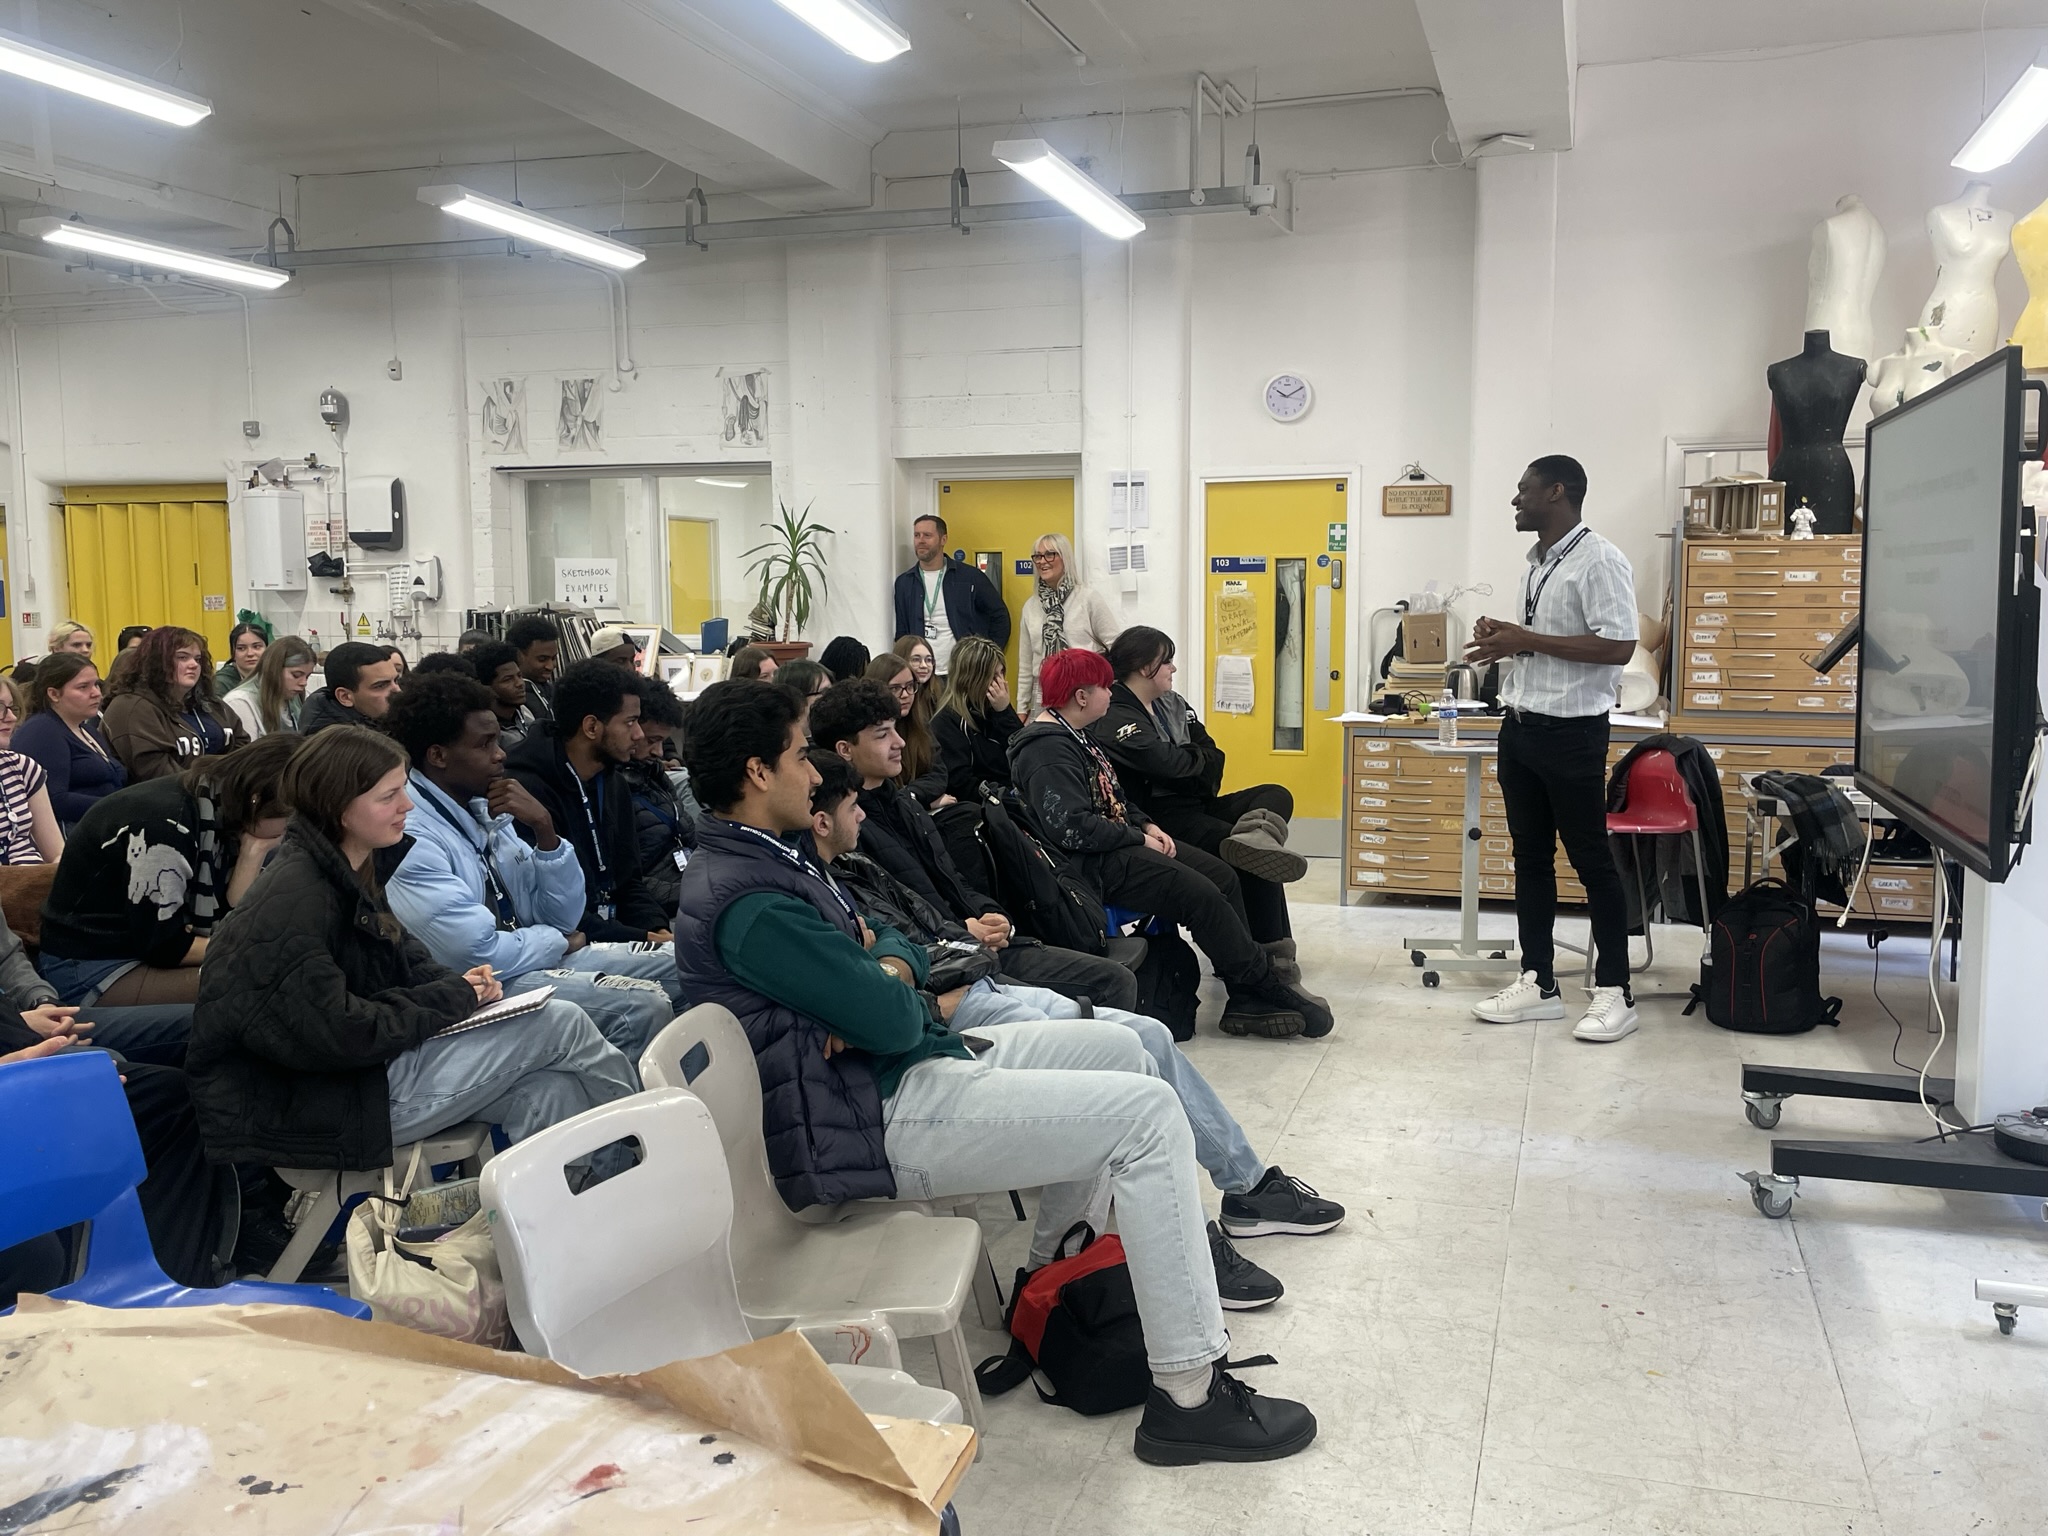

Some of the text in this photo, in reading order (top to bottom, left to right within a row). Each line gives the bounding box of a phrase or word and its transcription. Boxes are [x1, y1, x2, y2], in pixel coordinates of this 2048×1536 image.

[1216, 559, 1230, 567] 103
[561, 568, 611, 578] SKETCHBOOK
[565, 583, 609, 593] EXAMPLES
